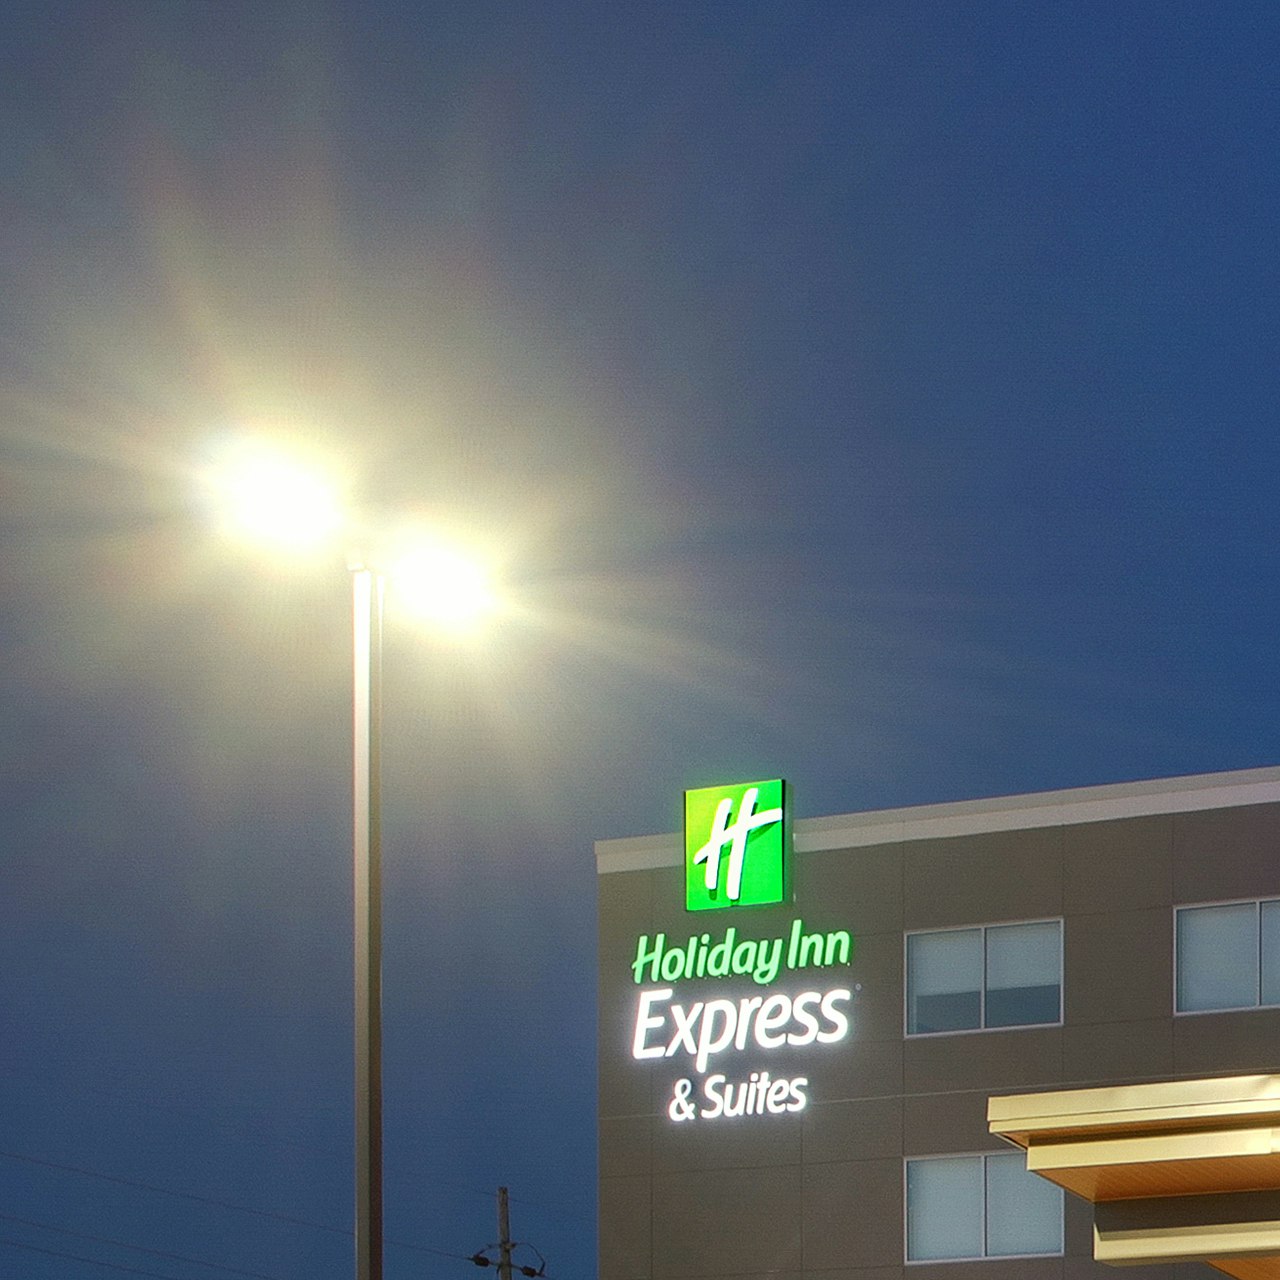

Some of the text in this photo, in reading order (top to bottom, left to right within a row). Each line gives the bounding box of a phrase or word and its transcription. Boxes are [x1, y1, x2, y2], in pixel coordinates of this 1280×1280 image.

[631, 919, 850, 985] Holiday Inn
[632, 988, 852, 1073] Express
[668, 1071, 808, 1122] & Suites
